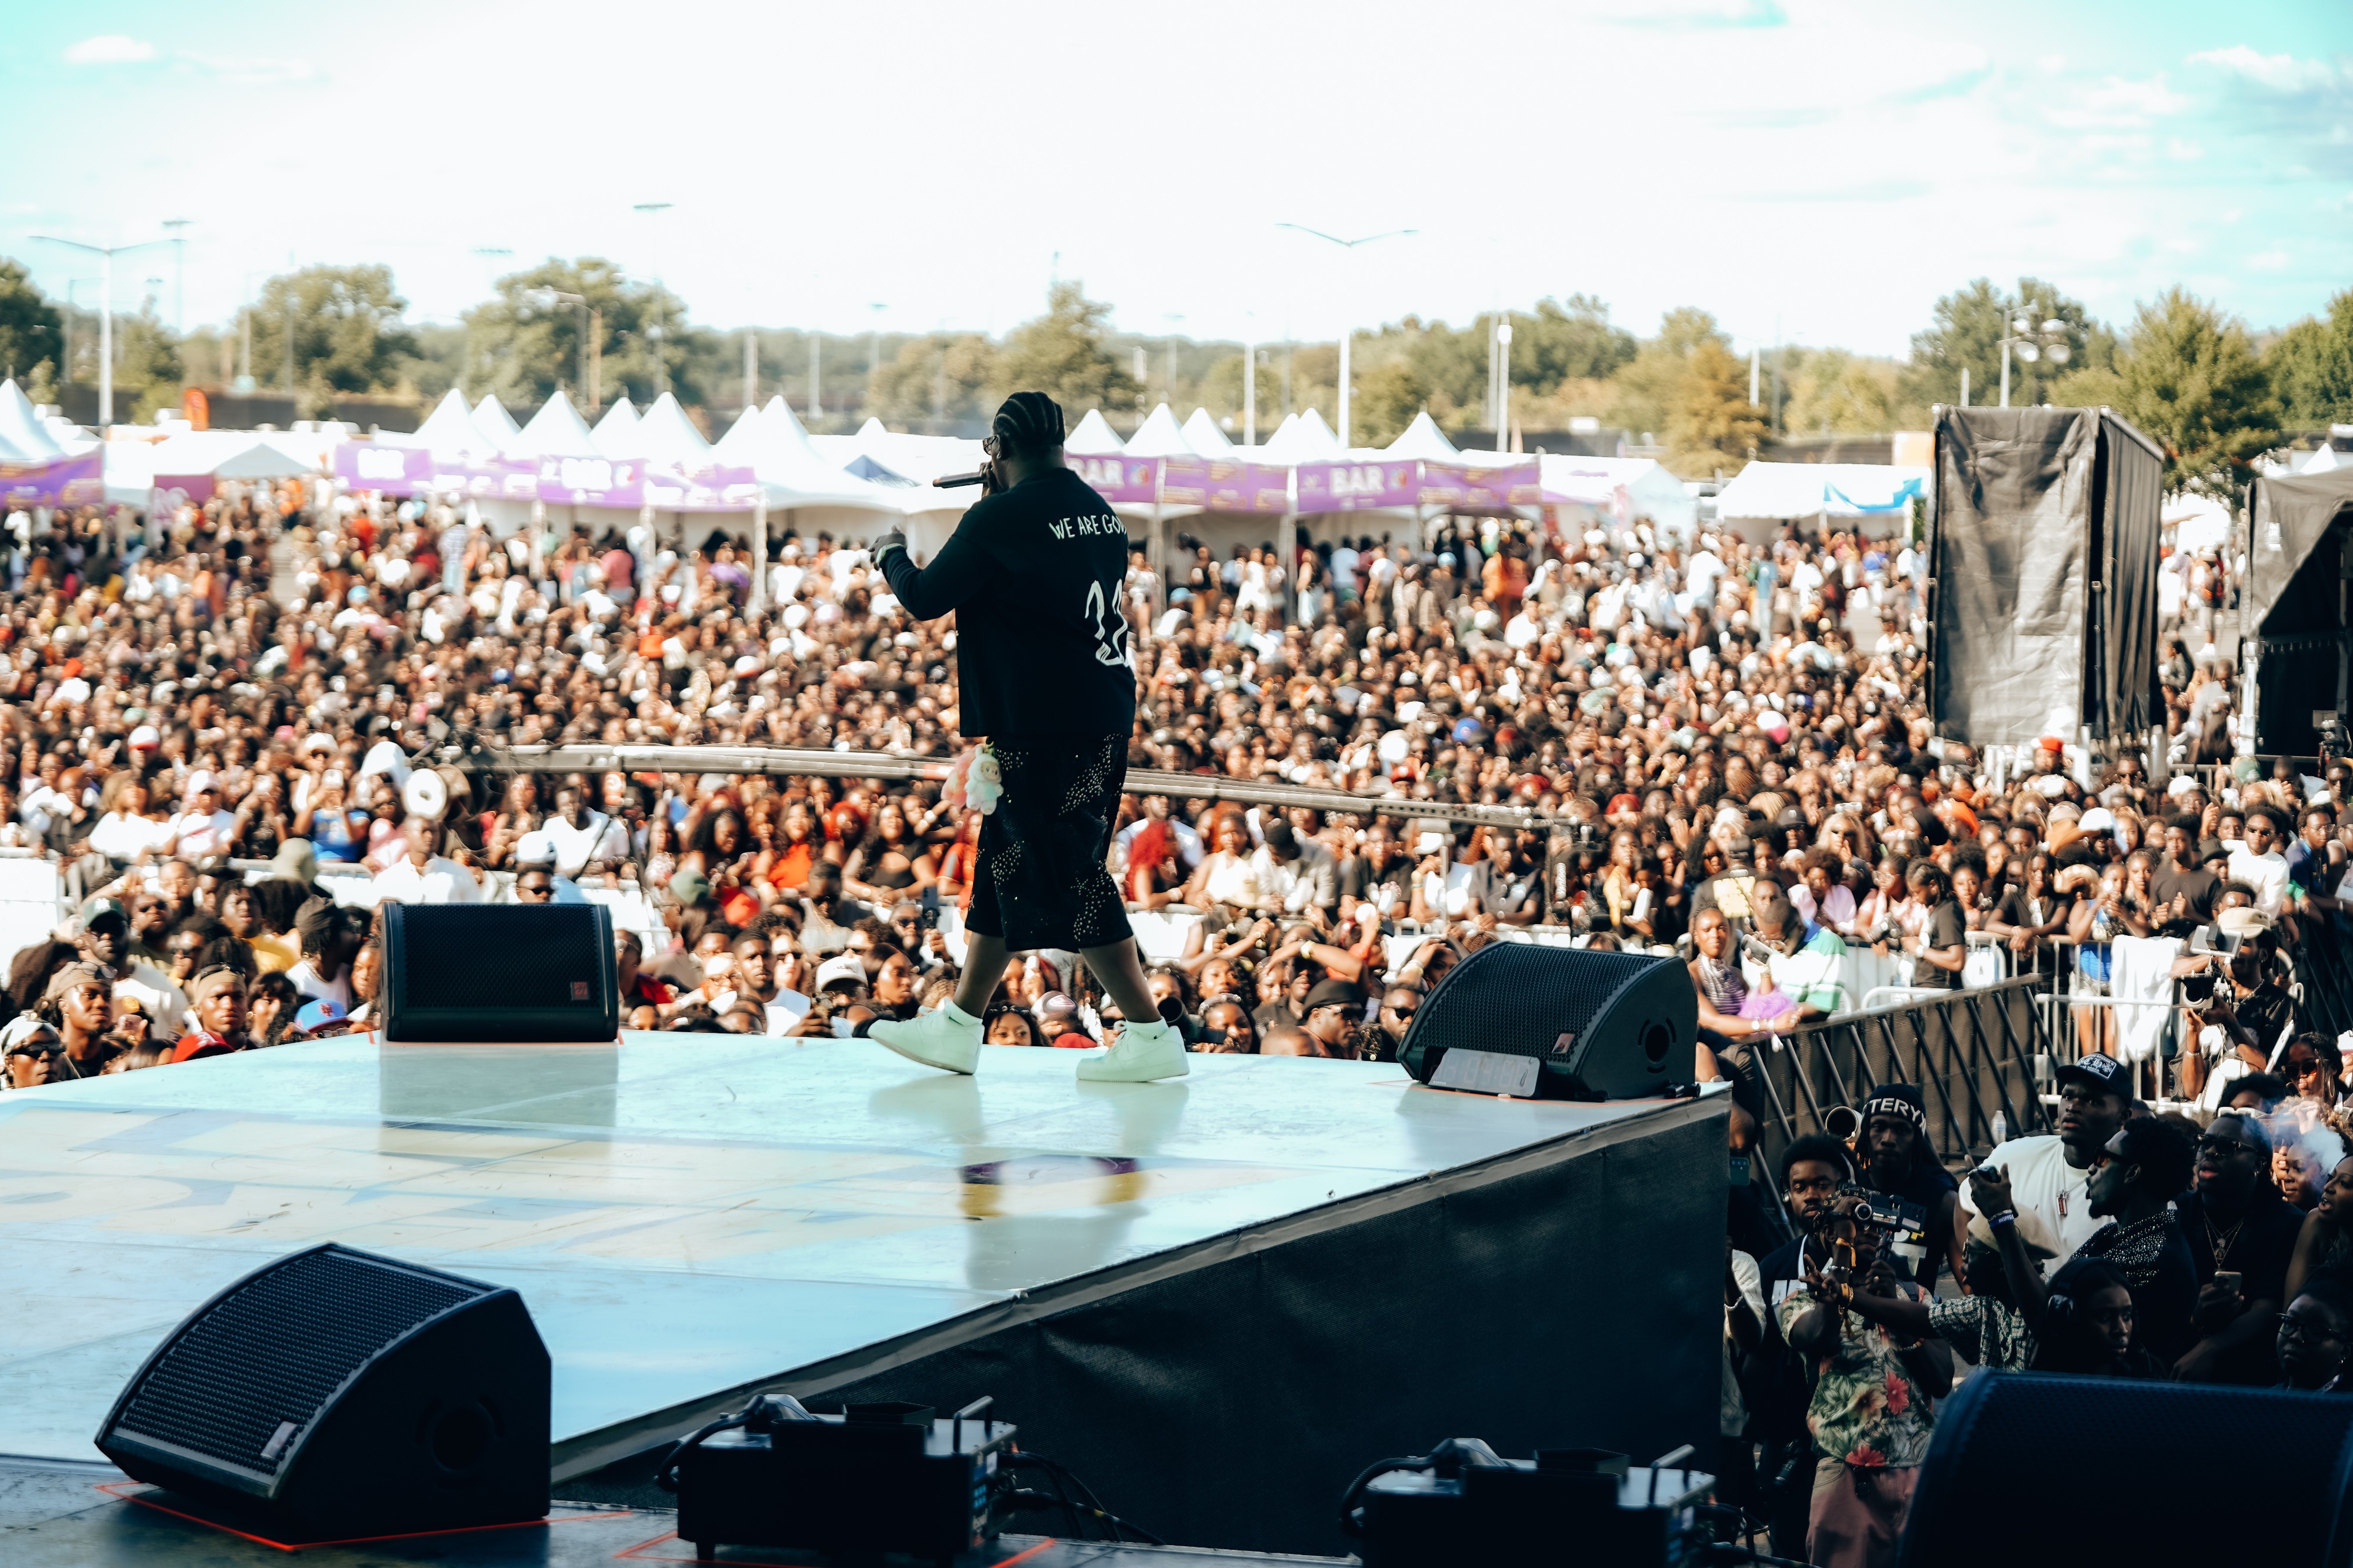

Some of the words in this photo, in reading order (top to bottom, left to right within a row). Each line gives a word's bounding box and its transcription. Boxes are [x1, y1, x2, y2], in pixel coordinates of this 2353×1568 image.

[1066, 457, 1125, 489] BAR
[1329, 466, 1386, 497] BAR
[1049, 518, 1075, 539] WE
[1077, 515, 1101, 535] ARE
